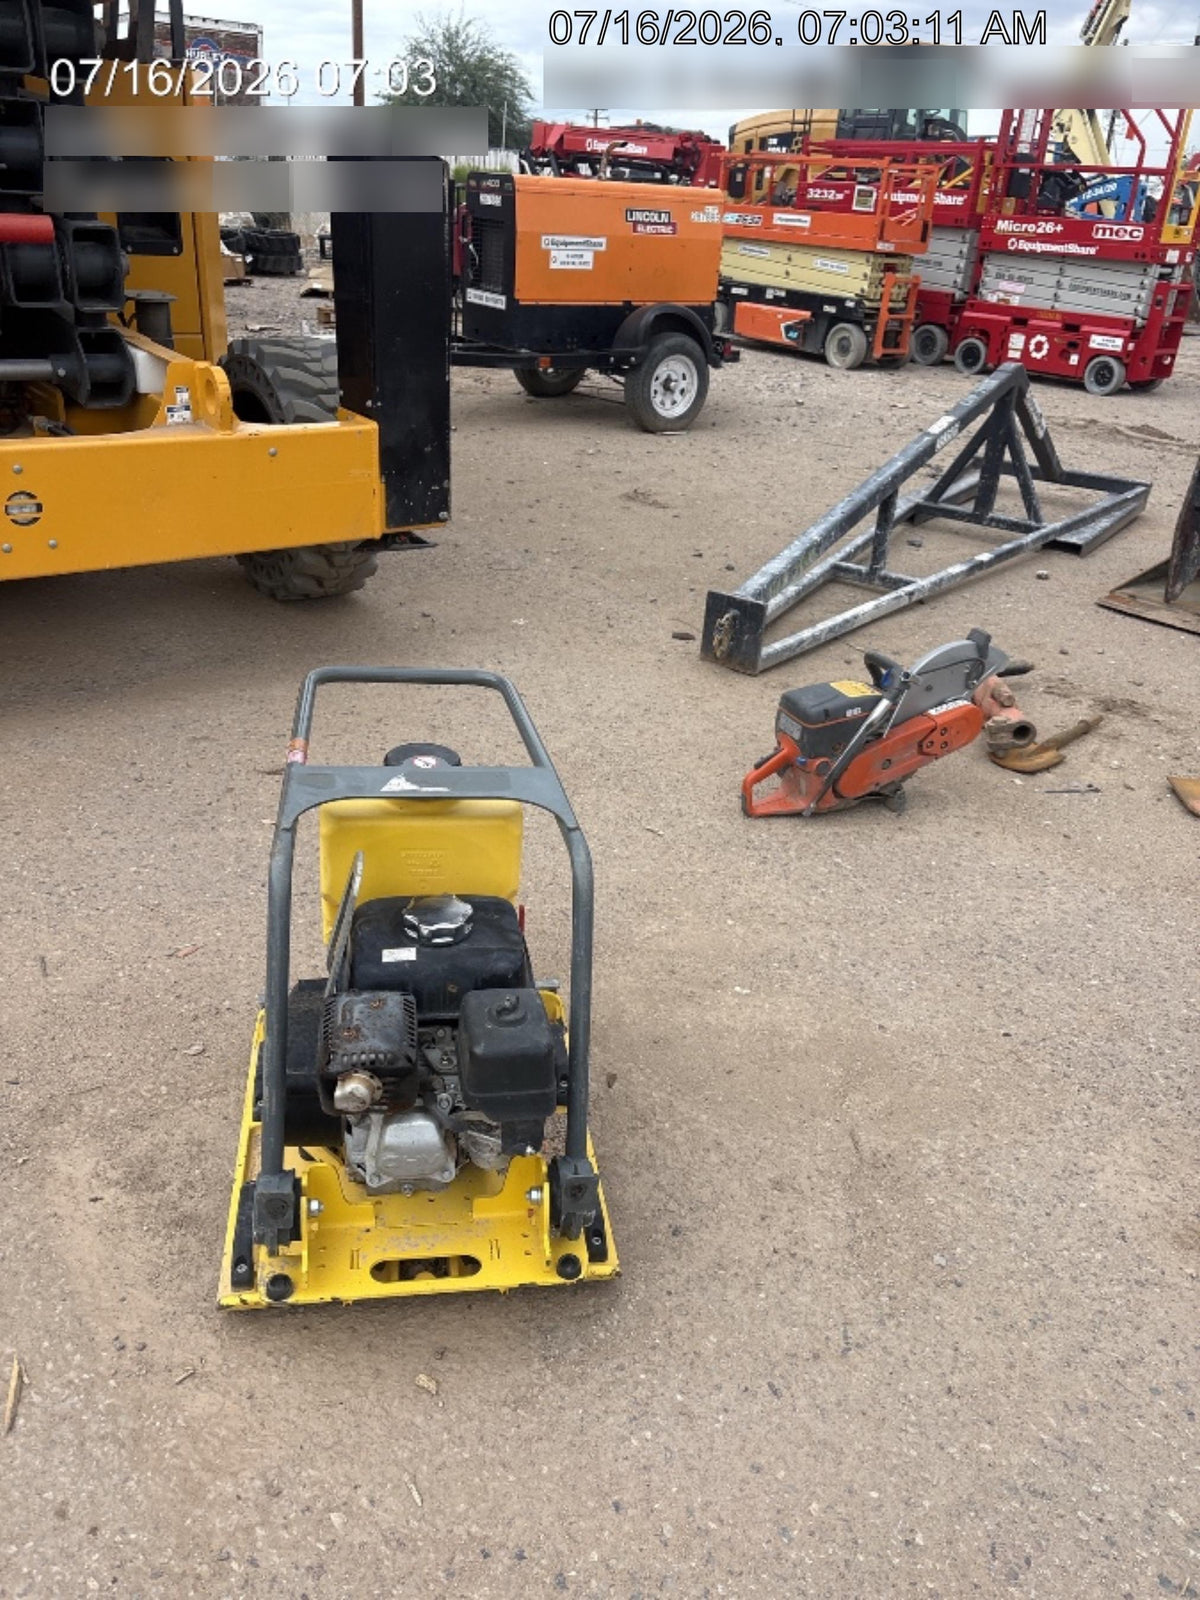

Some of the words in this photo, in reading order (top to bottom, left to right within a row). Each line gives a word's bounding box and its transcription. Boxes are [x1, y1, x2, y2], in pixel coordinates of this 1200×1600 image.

[626, 210, 670, 223] LINCOLN
[636, 223, 674, 234] ELECTRIC
[1093, 226, 1143, 240] mec
[1018, 239, 1097, 255] EquipmentShare
